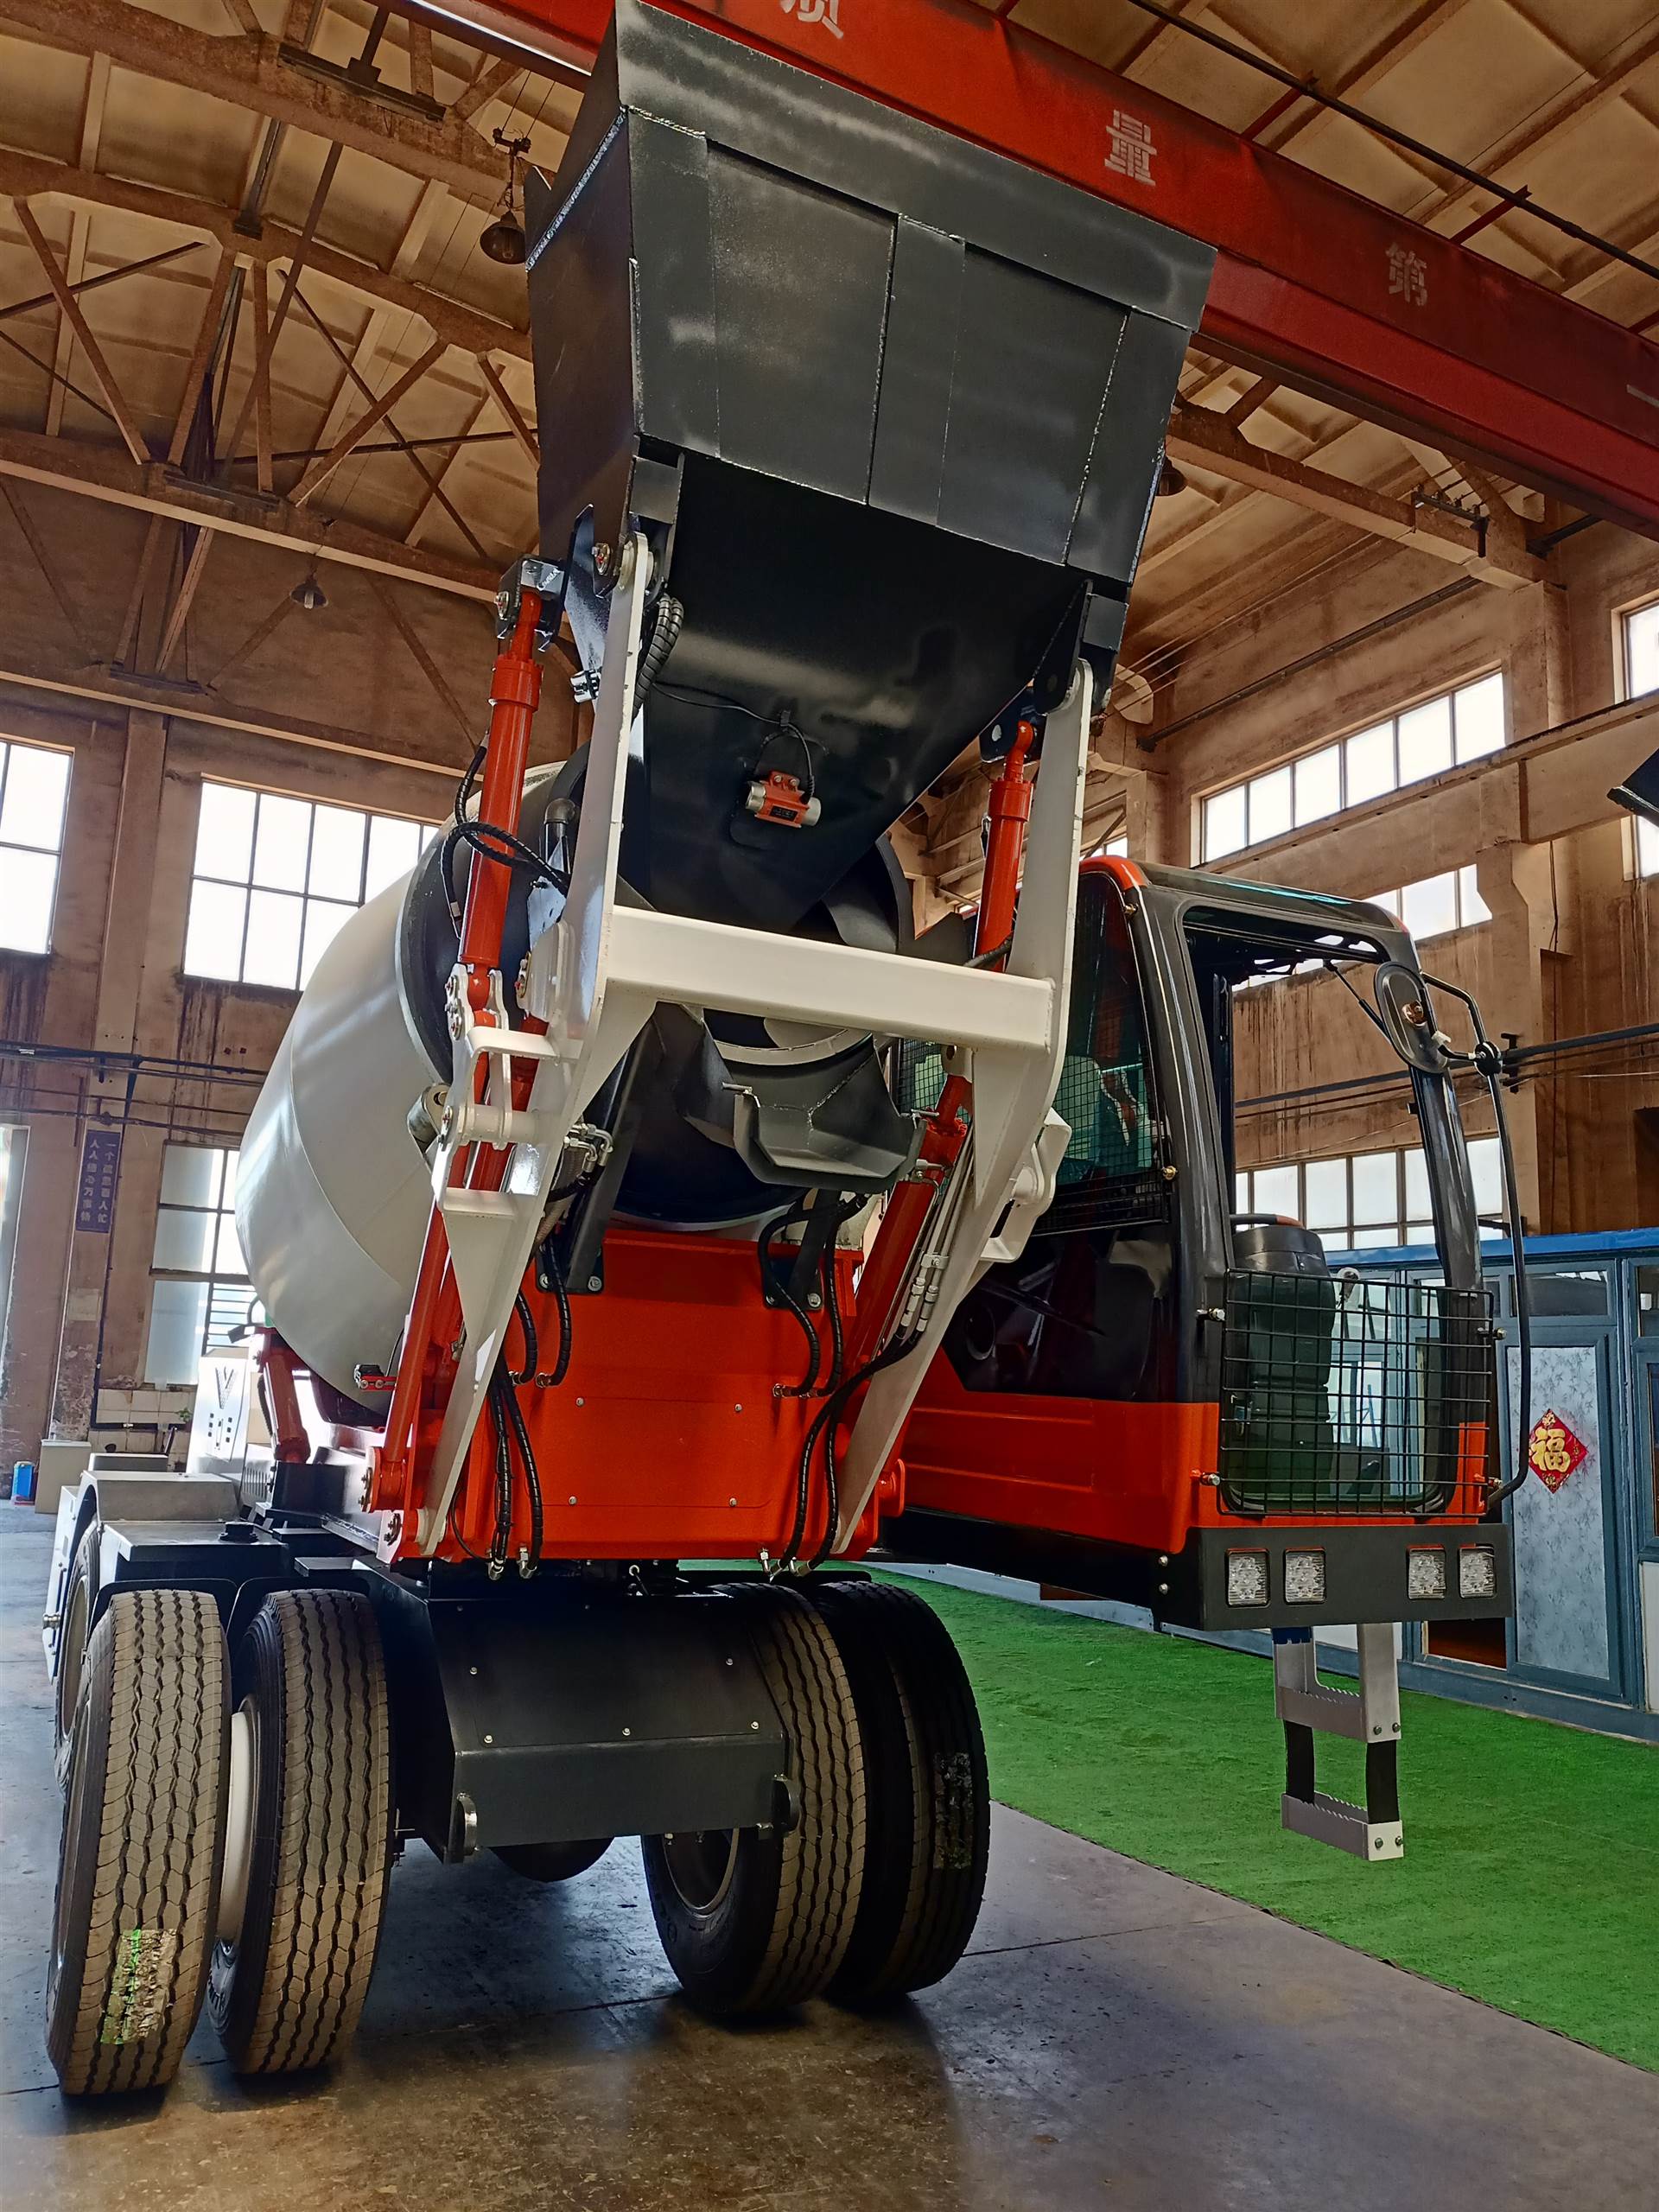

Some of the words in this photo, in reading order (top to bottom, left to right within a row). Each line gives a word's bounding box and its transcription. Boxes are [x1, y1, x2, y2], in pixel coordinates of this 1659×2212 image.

[1104, 109, 1157, 187] 量
[1385, 242, 1428, 307] 第
[1531, 1427, 1571, 1472] 福
